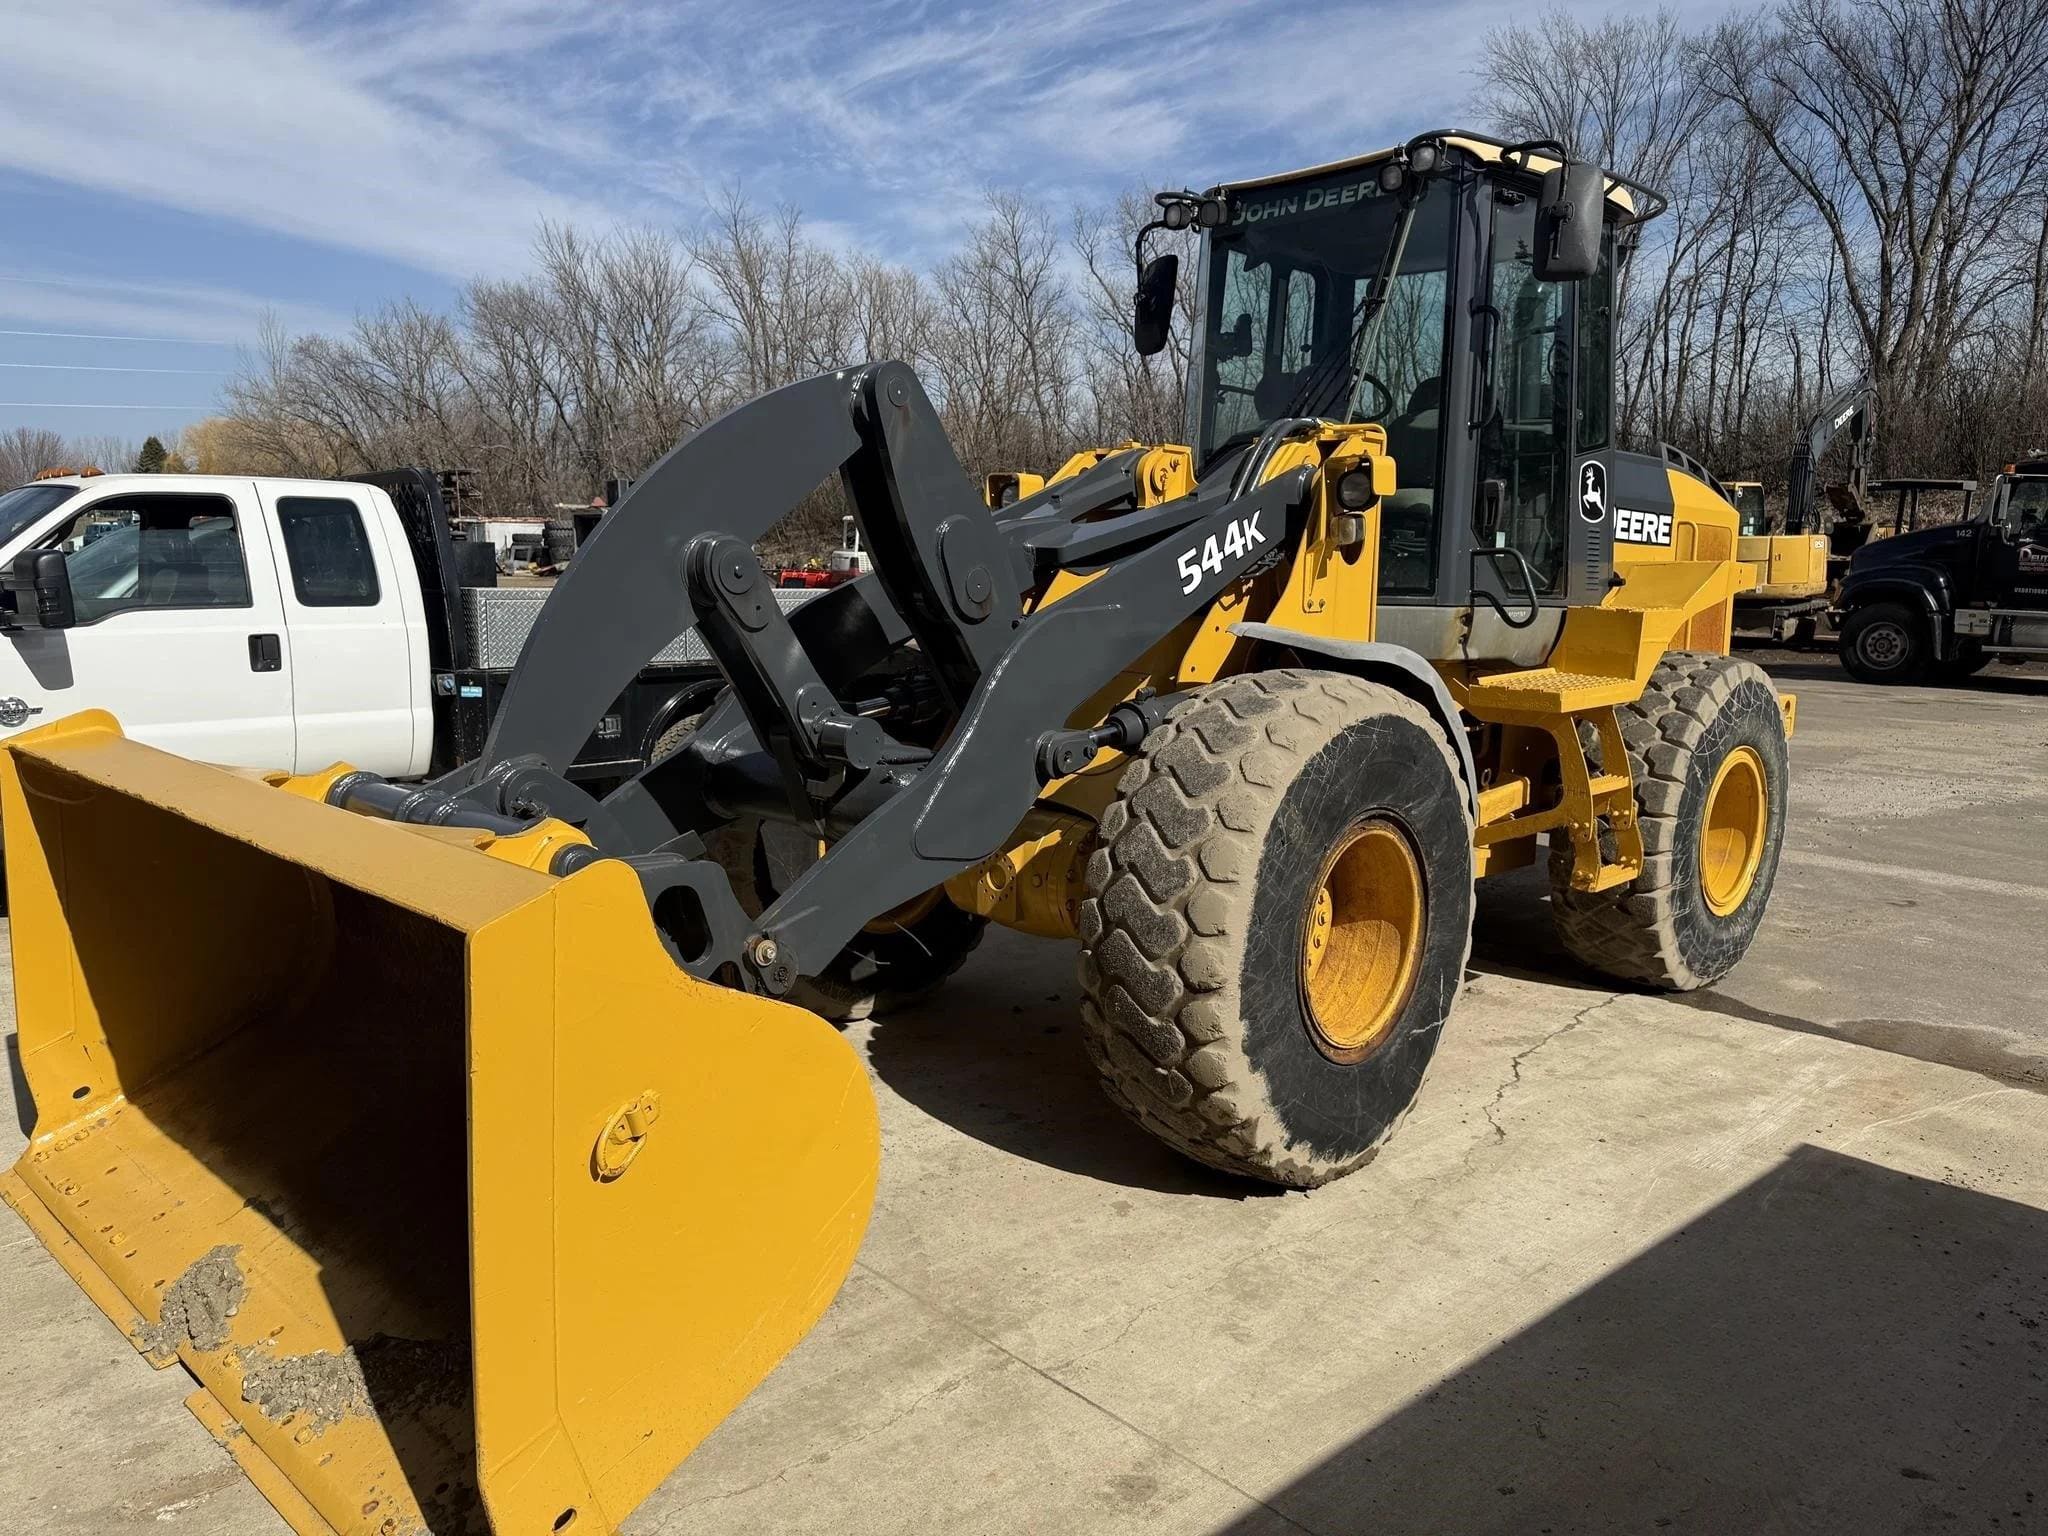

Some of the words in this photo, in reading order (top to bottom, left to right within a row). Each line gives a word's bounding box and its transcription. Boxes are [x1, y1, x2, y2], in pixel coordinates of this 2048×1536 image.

[1232, 196, 1298, 226] JOHN
[1835, 405, 1854, 430] DEERE
[1613, 506, 1672, 545] EERE
[1956, 529, 1973, 538] 142
[1177, 509, 1267, 596] 544K
